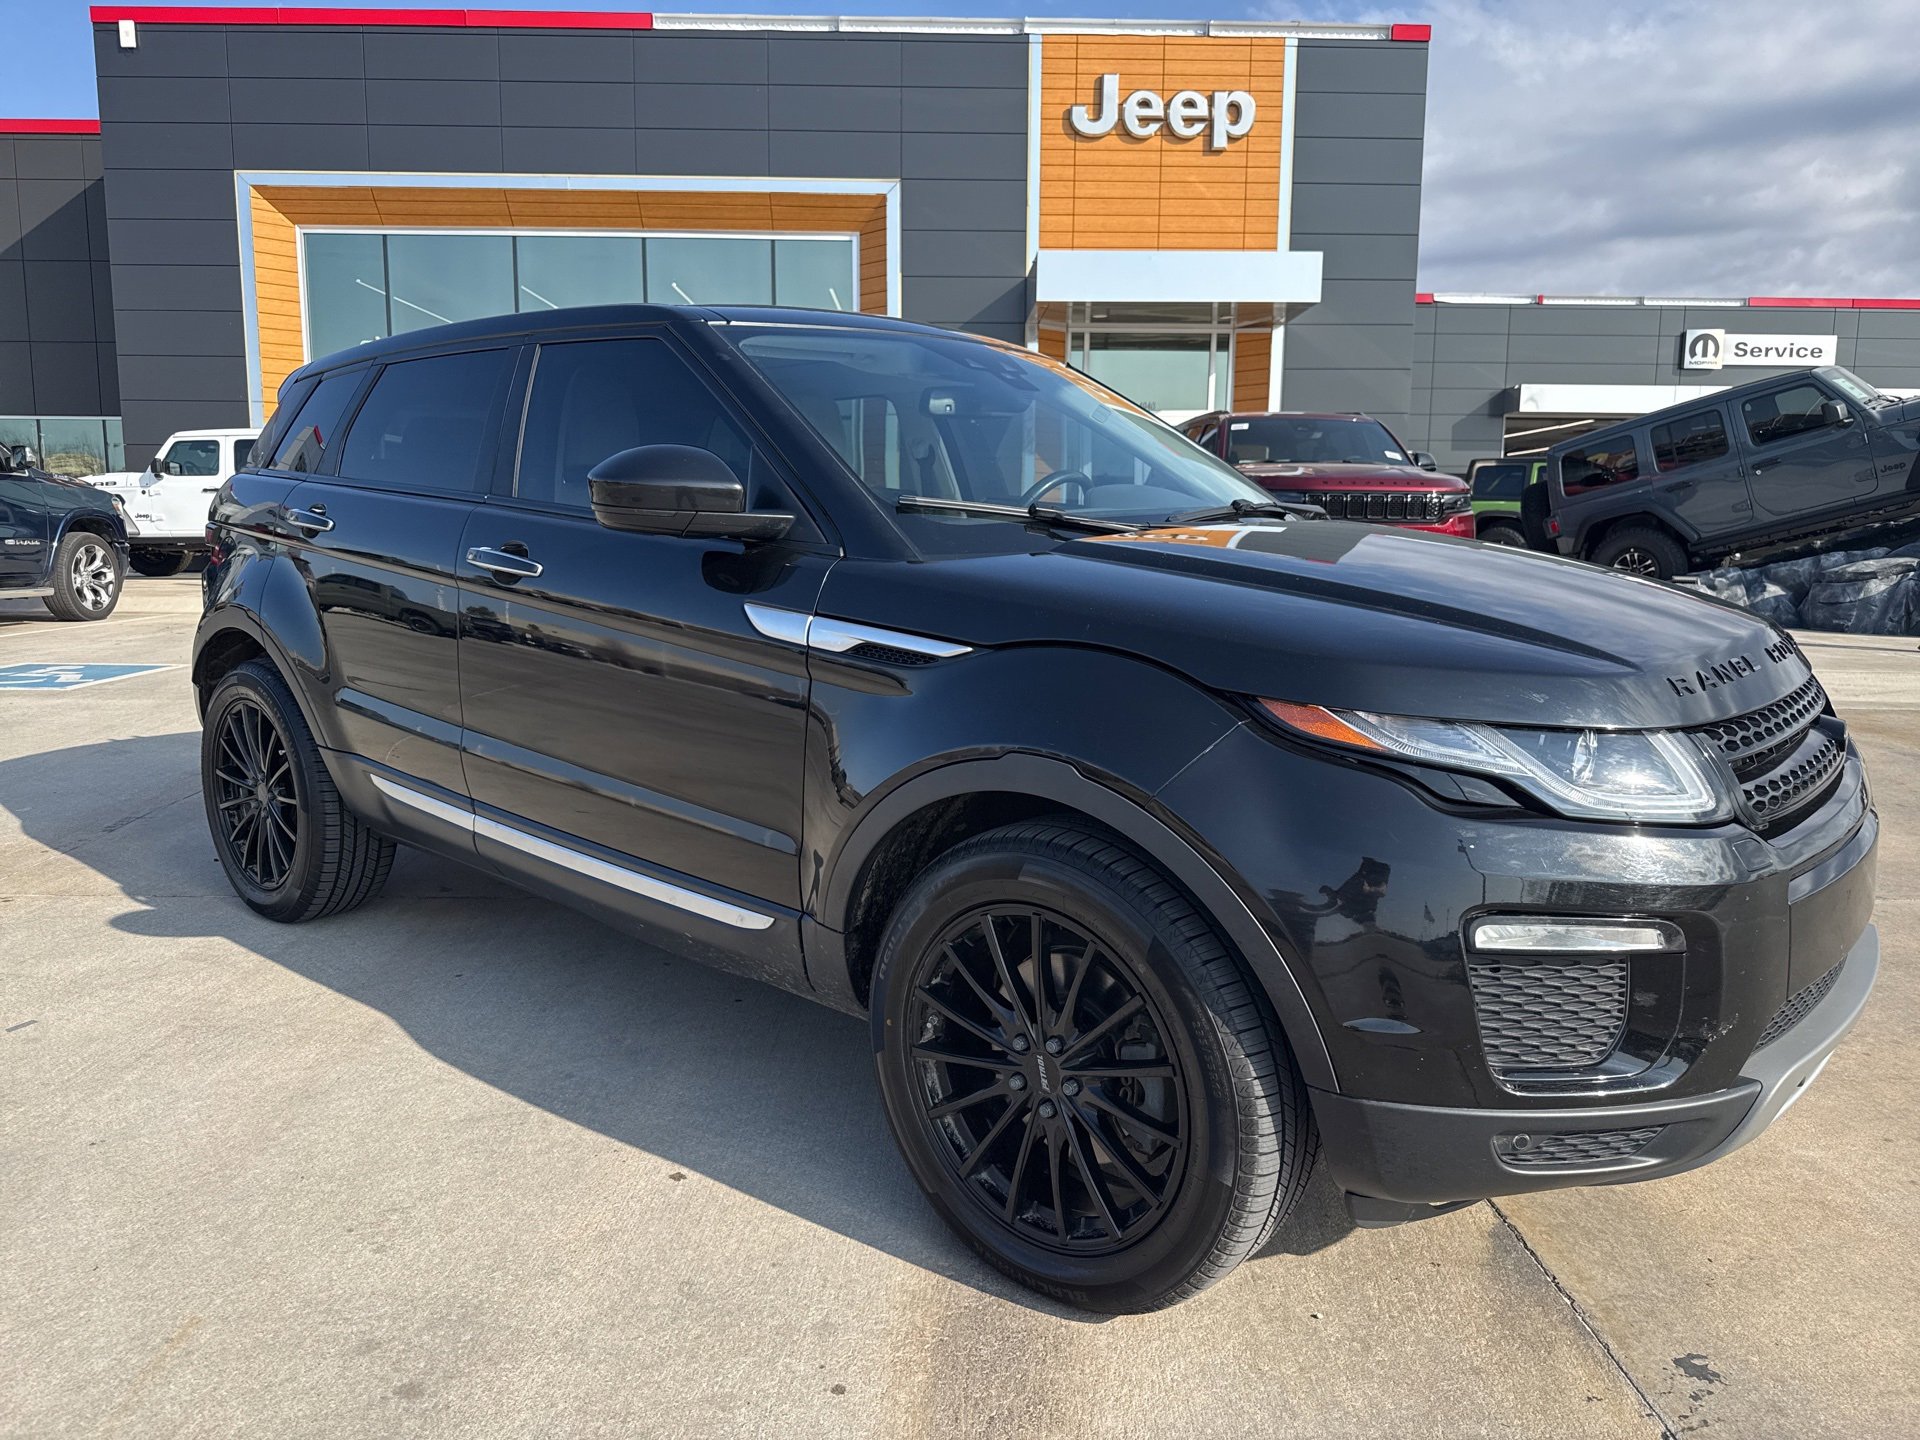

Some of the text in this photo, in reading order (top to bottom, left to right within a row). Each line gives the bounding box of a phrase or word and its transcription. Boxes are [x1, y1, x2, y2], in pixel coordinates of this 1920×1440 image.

[1070, 73, 1256, 151] Jeep
[1733, 341, 1823, 358] Service
[1880, 462, 1906, 473] Jeep
[134, 512, 150, 520] Jeep
